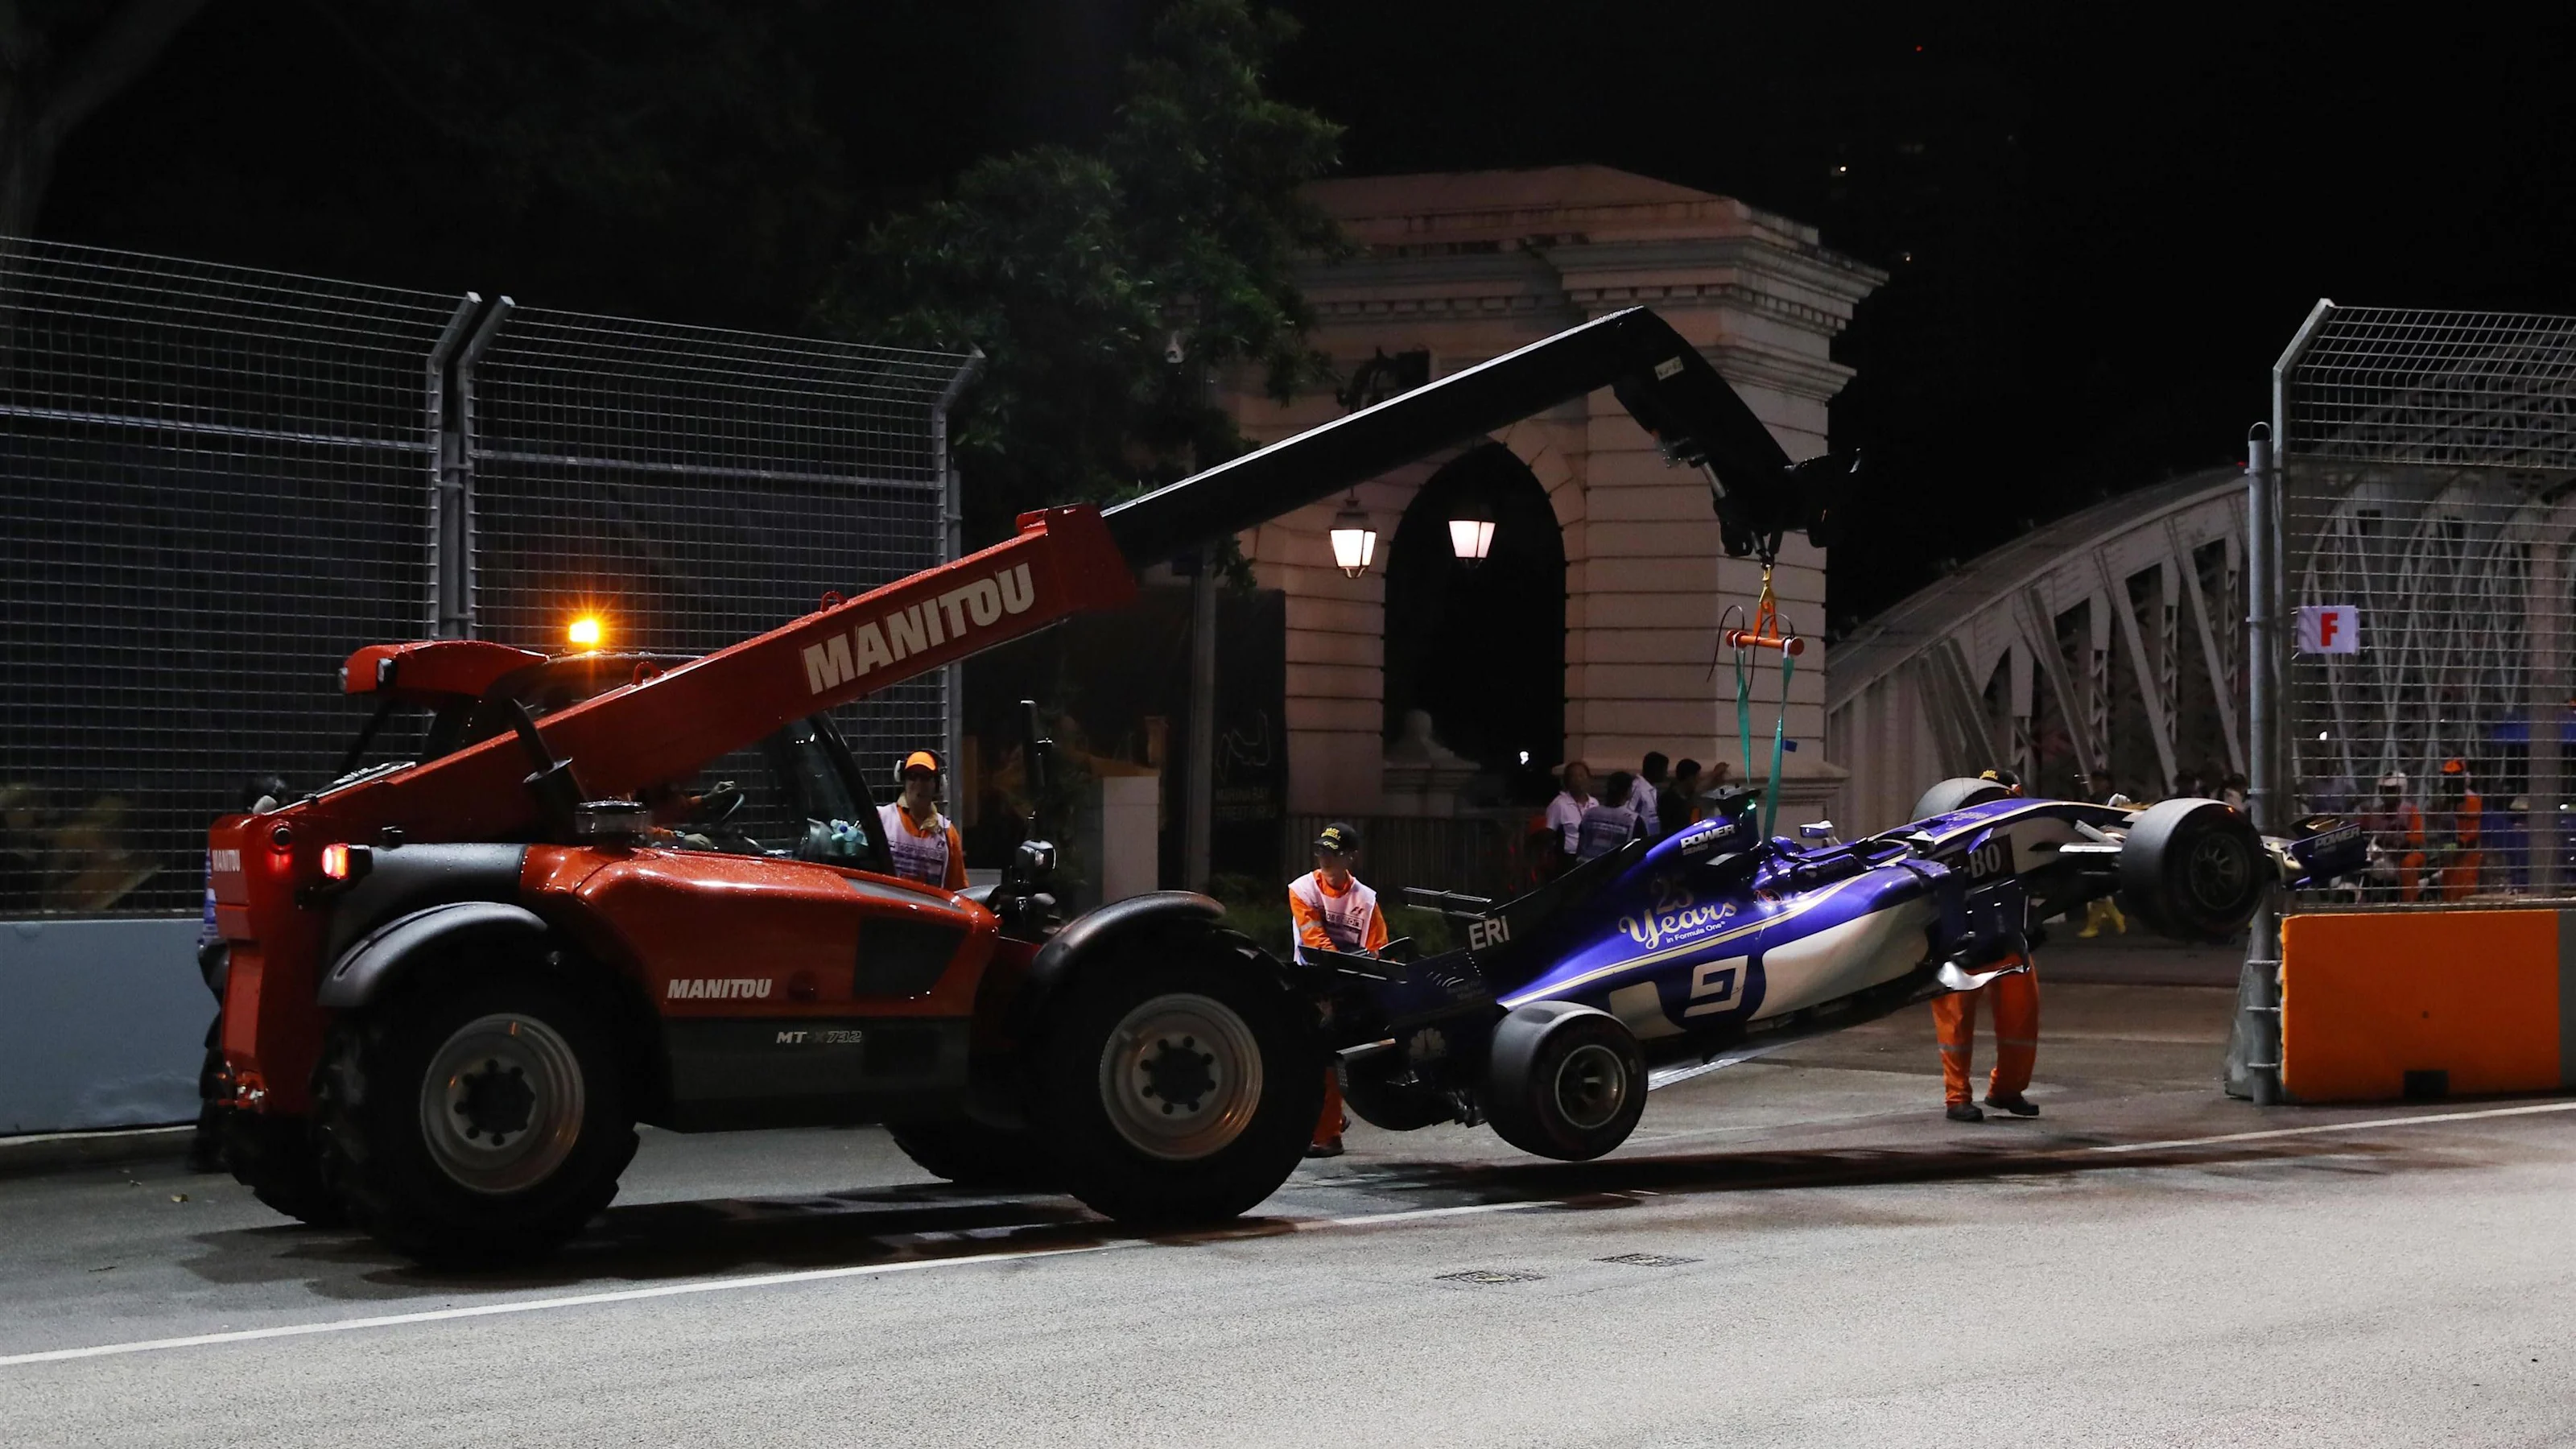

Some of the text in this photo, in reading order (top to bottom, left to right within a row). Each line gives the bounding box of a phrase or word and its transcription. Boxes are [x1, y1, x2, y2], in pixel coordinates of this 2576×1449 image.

[803, 563, 1034, 695] MANITOU
[2321, 613, 2338, 646] F
[1680, 824, 1736, 848] POWER
[2314, 826, 2360, 850] POWER
[212, 849, 241, 872] MANITOU
[1650, 873, 1695, 914] 25
[1468, 915, 1510, 951] ERI
[1618, 902, 1737, 949] Years
[1666, 935, 1674, 943] in
[1674, 928, 1705, 941] Formula
[667, 979, 772, 998] MANITOU
